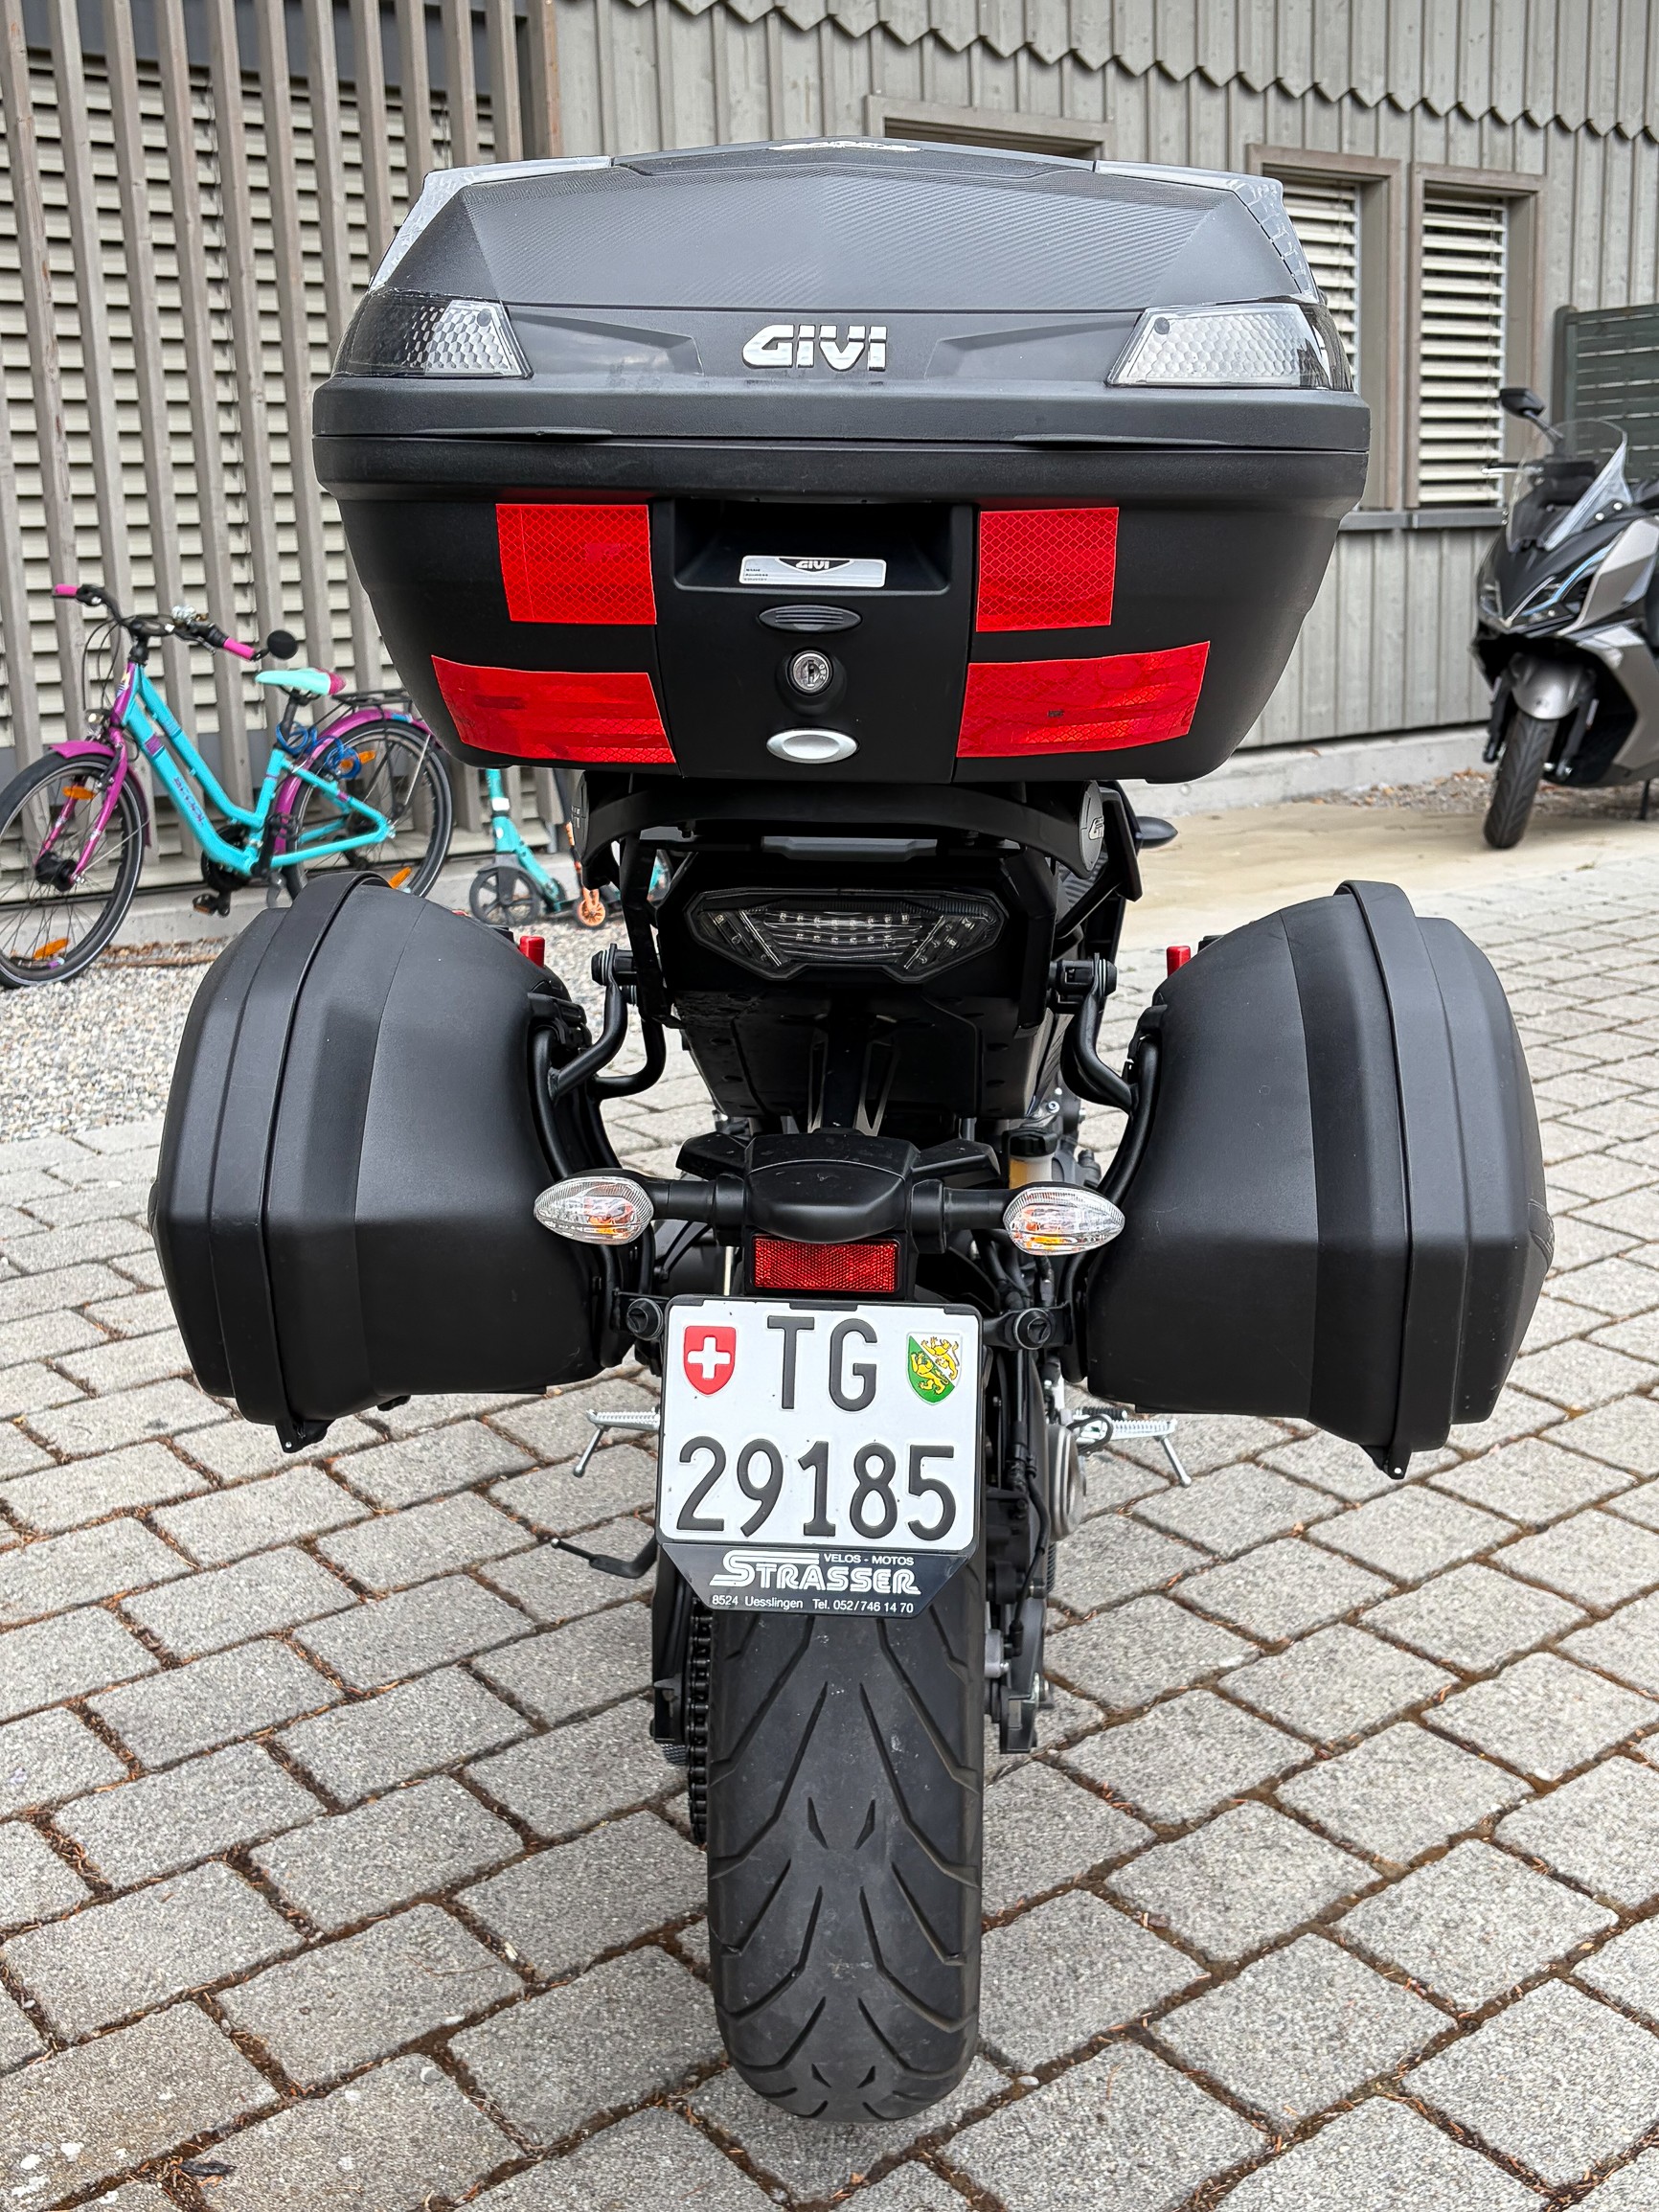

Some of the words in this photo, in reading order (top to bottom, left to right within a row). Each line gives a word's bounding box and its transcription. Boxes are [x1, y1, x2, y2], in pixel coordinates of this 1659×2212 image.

[742, 324, 887, 372] GIVI
[795, 560, 830, 570] GIVI
[766, 1314, 878, 1412] TG
[676, 1436, 957, 1541] 29185
[709, 1549, 921, 1595] STRASSER
[824, 1553, 861, 1563] VELOS
[872, 1555, 915, 1566] MOTOS
[712, 1594, 739, 1606] 8524
[745, 1596, 804, 1610] Uesslingen
[812, 1599, 830, 1610] Tel.
[833, 1601, 881, 1612] 052/746
[884, 1602, 897, 1612] 14
[899, 1603, 914, 1613] 70
